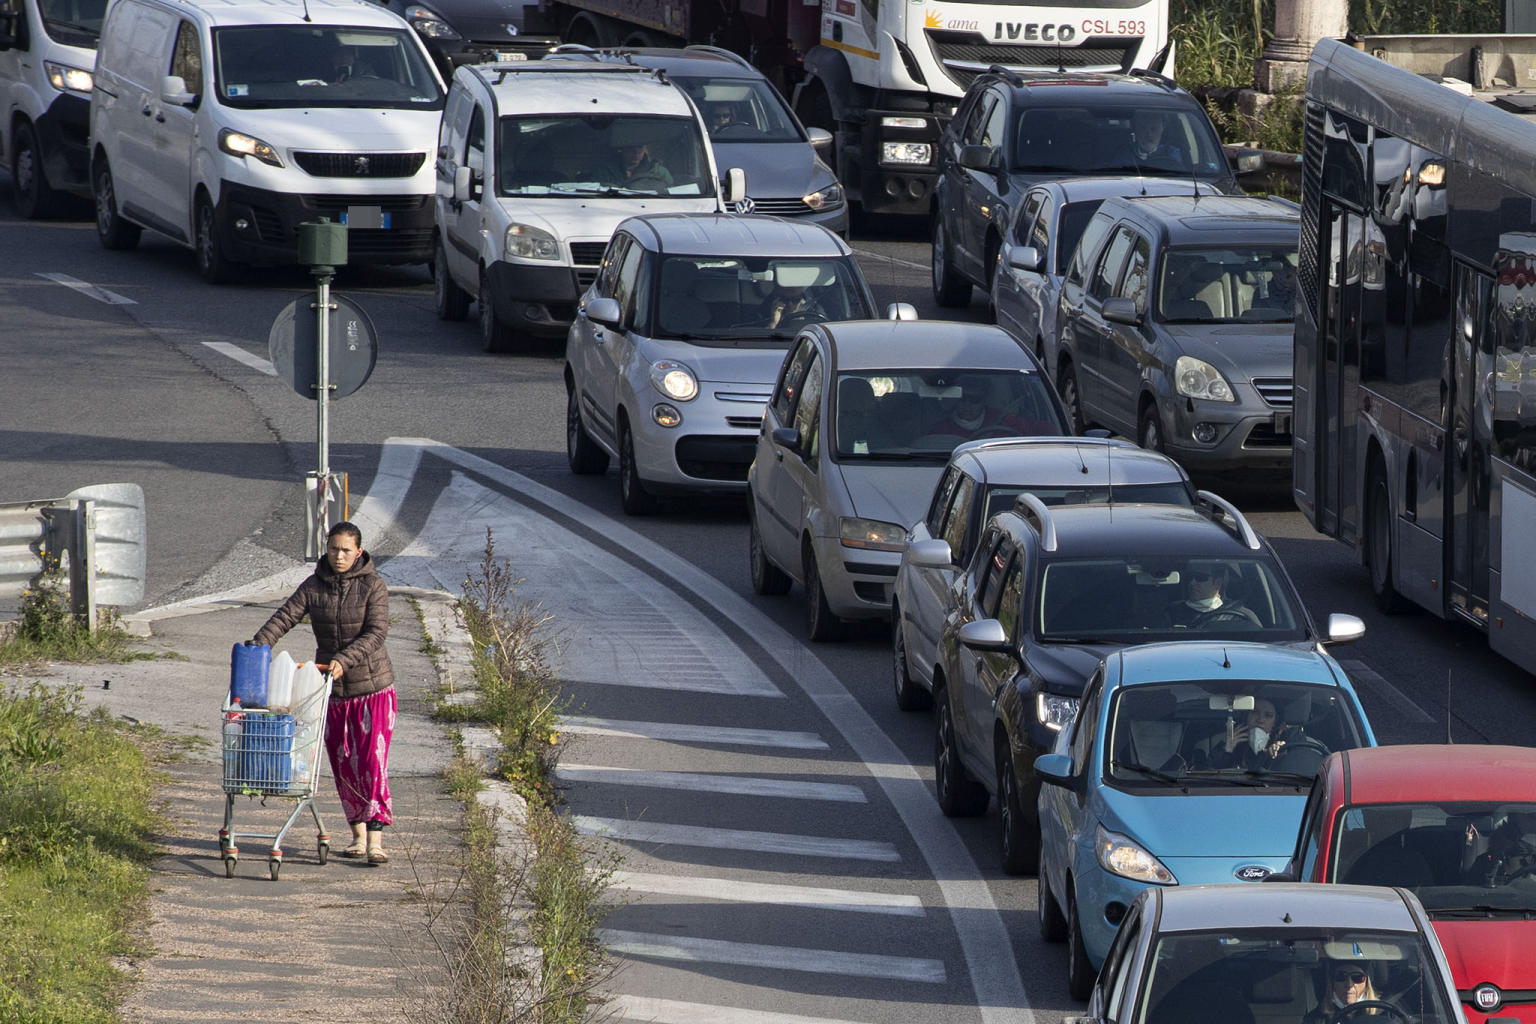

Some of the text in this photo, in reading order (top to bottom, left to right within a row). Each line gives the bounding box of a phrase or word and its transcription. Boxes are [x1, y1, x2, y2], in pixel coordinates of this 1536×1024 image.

[947, 18, 979, 31] ama
[994, 21, 1076, 42] IVECO
[1081, 19, 1146, 35] CSL 593
[1243, 868, 1266, 878] Ford
